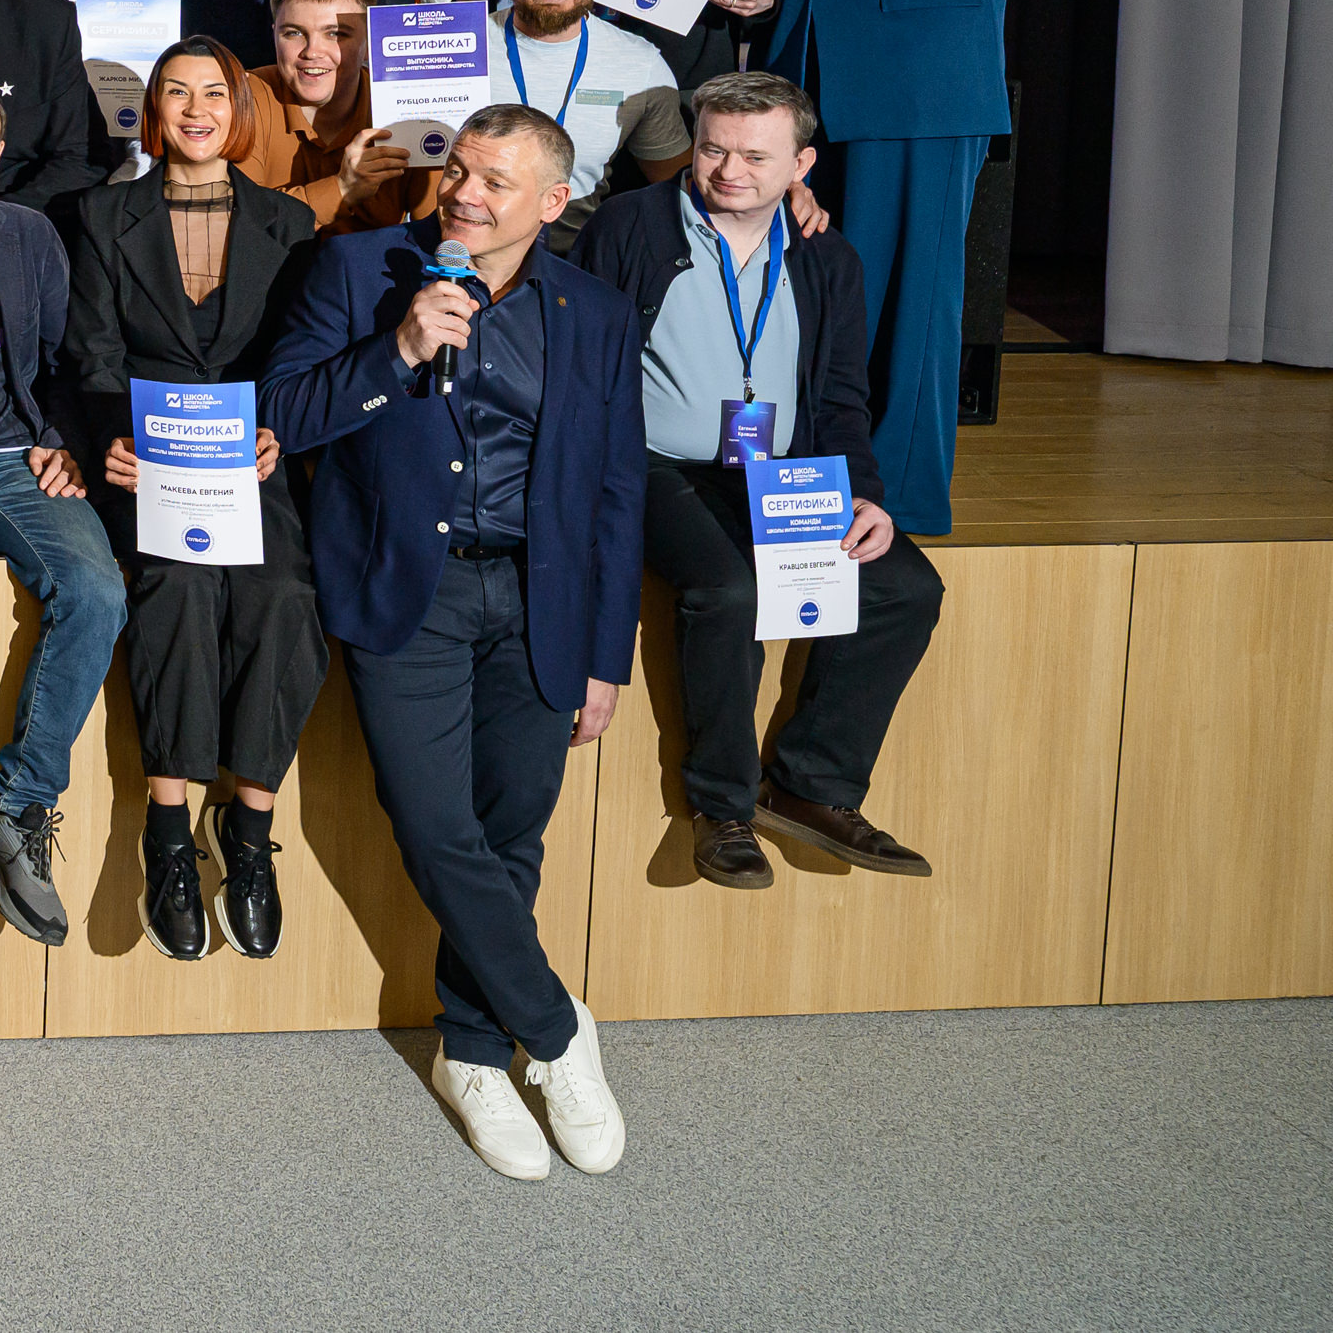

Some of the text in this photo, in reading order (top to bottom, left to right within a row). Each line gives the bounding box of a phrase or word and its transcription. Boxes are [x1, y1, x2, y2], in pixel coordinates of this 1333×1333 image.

[91, 26, 165, 35] СЕРТИФИКАТ
[388, 38, 471, 51] СЕРТИФИКАТ
[406, 57, 454, 65] ВЫПУСКНИКА
[396, 95, 470, 106] РУБЦОВ АЛЕКСЕЙ
[150, 421, 240, 436] СЕРТИФИКАТ
[169, 442, 222, 452] ВЫПУСКНИКА
[160, 484, 234, 496] МАКЕЕВА ЕВГЕНИЯ
[767, 497, 838, 511] СЕРТИФИКАТ
[790, 517, 821, 526] КОМАНДЫ
[779, 559, 836, 571] КРАВЦОВ ЕВГЕНИЙ
